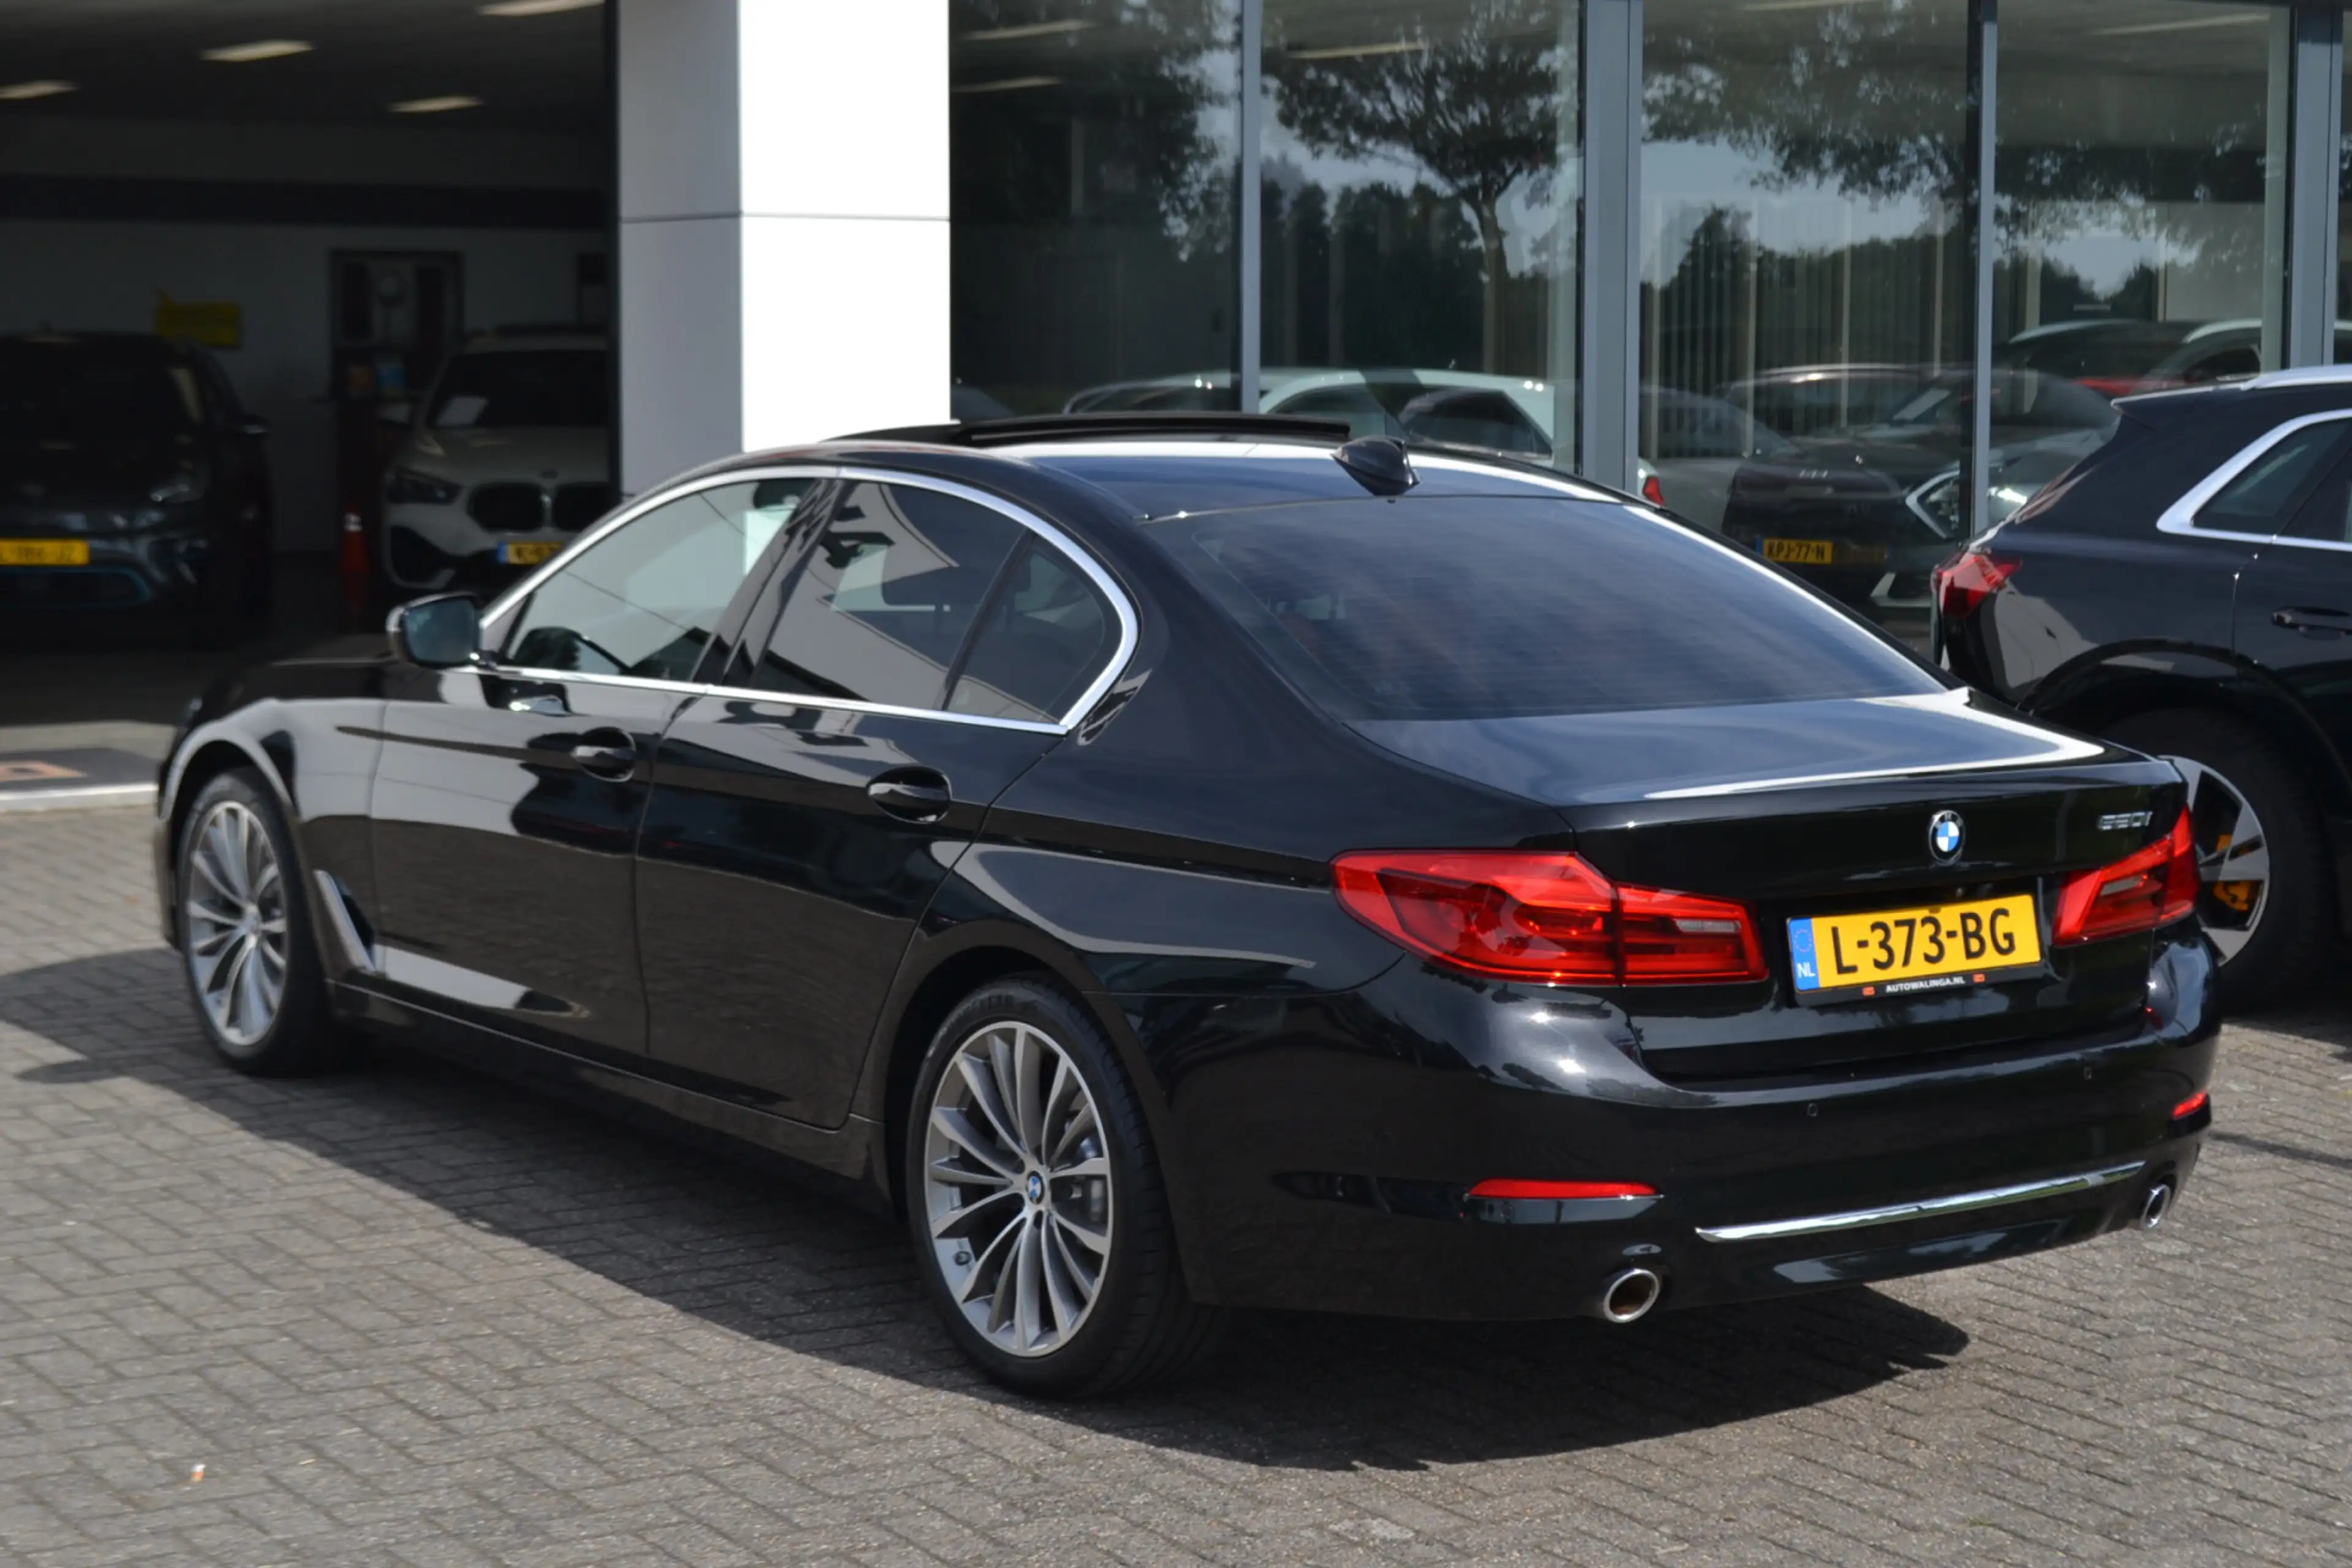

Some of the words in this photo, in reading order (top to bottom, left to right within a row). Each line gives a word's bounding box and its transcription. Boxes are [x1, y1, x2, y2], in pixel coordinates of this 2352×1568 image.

[1831, 907, 2016, 975] L-373-BG
[1796, 962, 1816, 978] NL
[1885, 976, 1966, 993] AUTOWALINGA.NL
